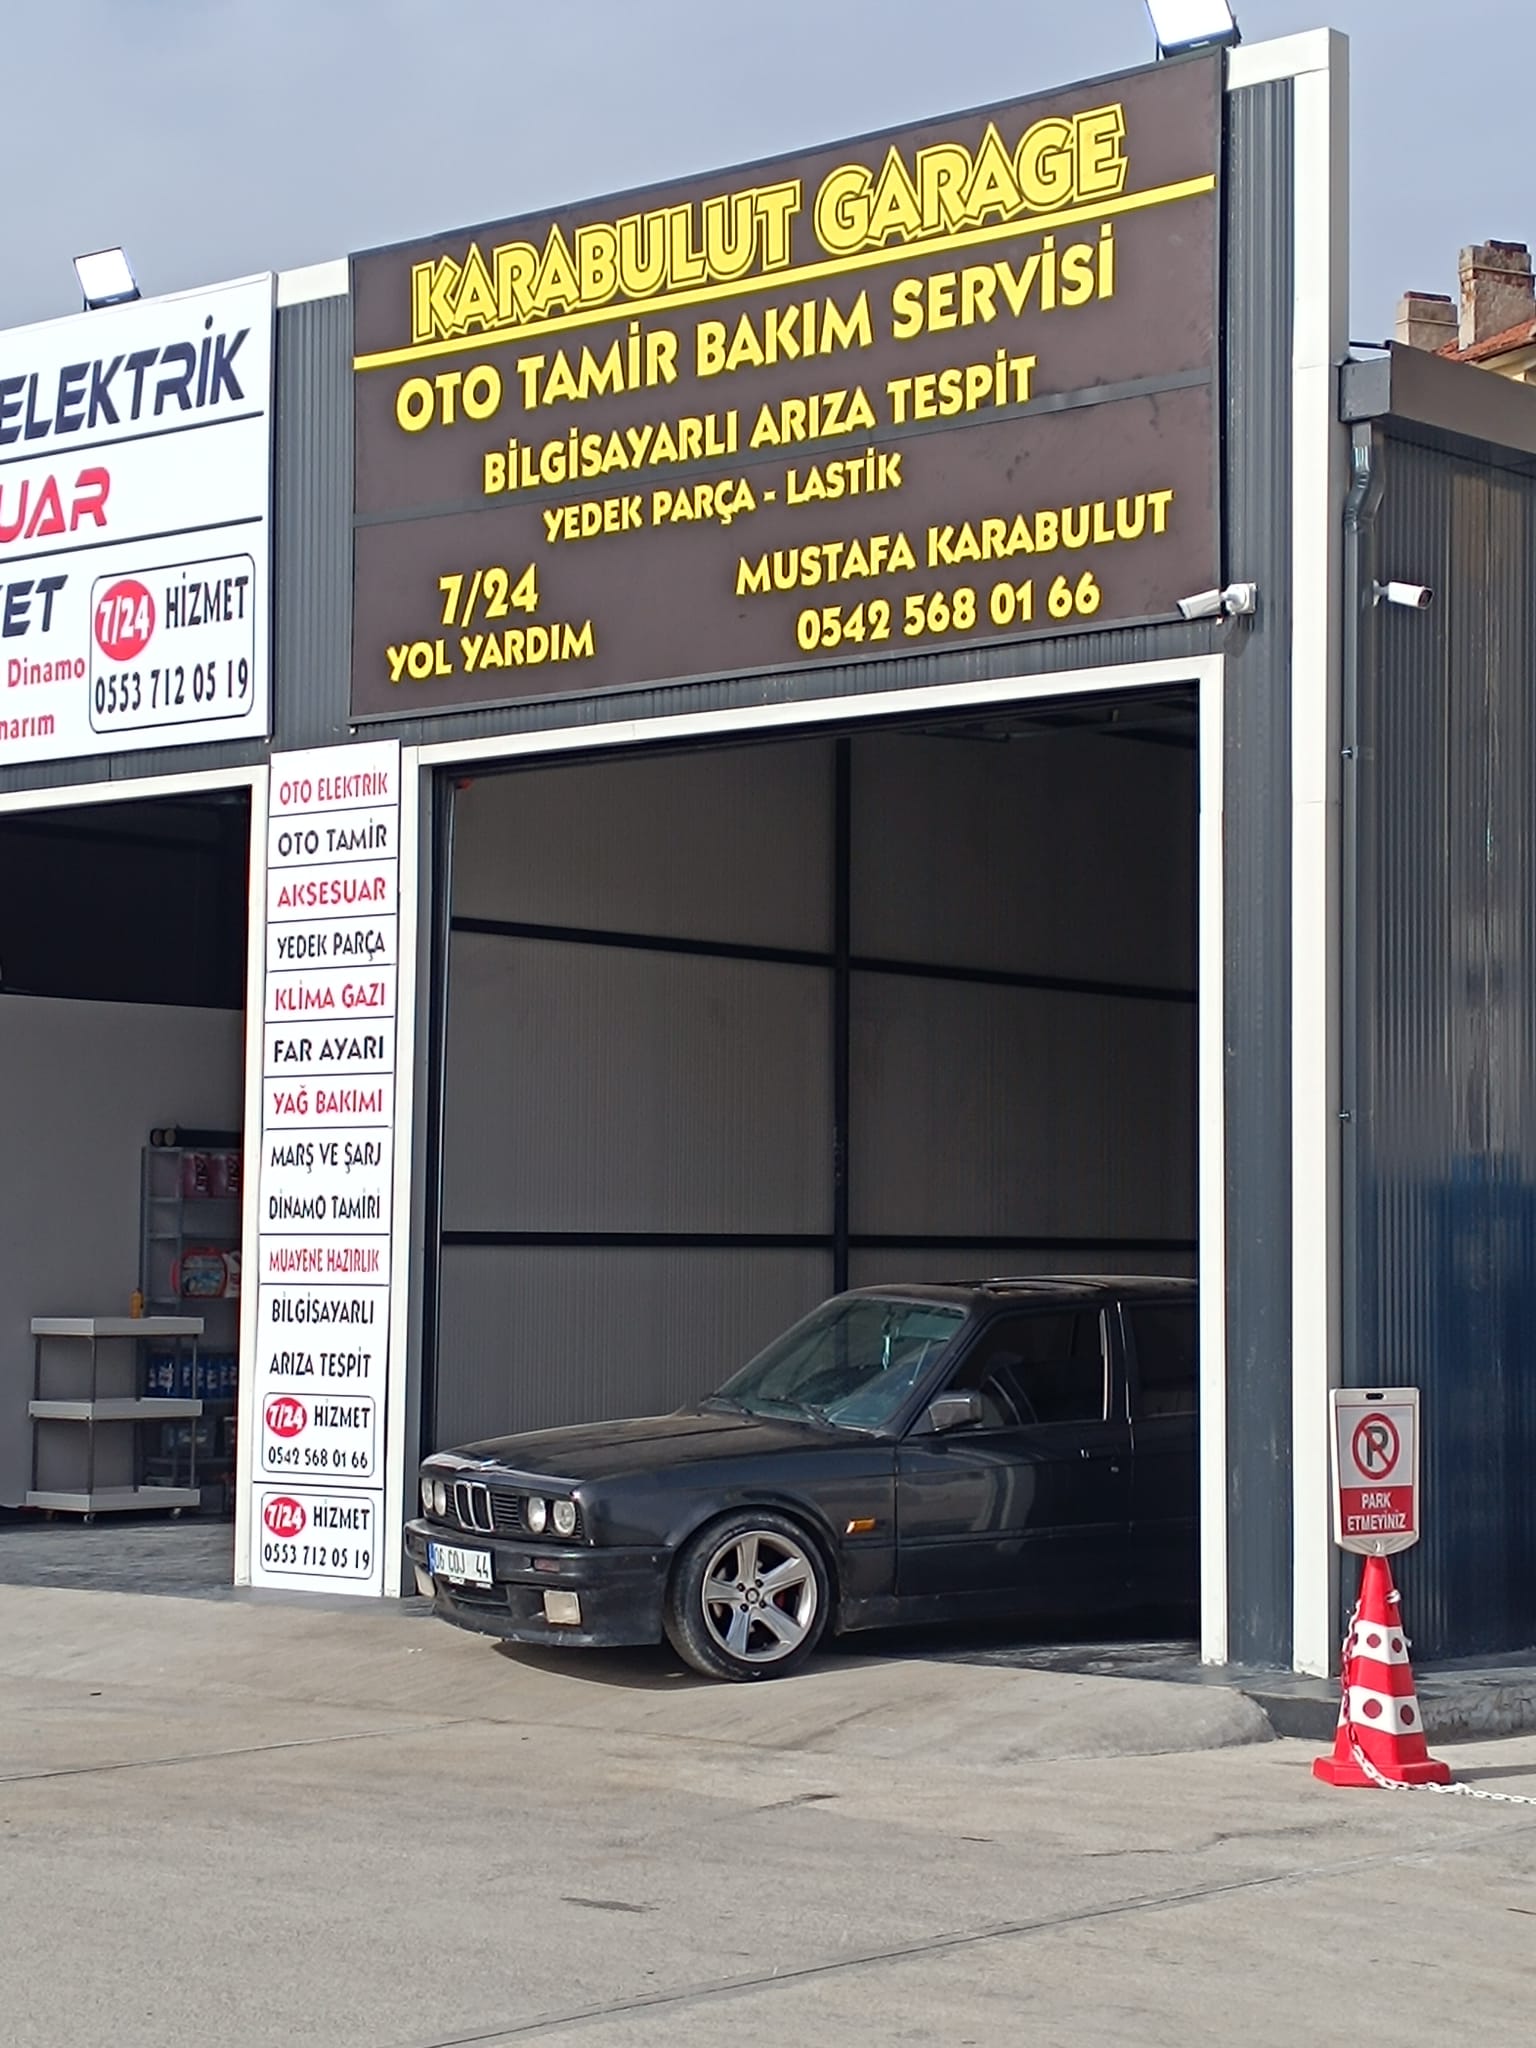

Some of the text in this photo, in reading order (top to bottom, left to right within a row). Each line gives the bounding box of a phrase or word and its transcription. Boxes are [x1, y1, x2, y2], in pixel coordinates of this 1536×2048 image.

[412, 103, 1128, 343] KARABULUT GARAGE
[396, 222, 1114, 432] OTO TAMİR BAKIM SERVİSİ
[0, 314, 250, 445] ELEKTRİK
[484, 348, 1037, 495] BİLGİSAYARLI ARIZA TESPİT
[543, 495, 643, 542] YEDEK
[652, 478, 756, 525] PARÇA
[787, 447, 902, 505] LASTİK
[736, 490, 1174, 596] MUSTAFA KARABULUT
[0, 575, 68, 637] ET
[99, 571, 249, 645] 7/24 HİZMET
[439, 563, 539, 628] 7/24
[797, 571, 1101, 650] 0542 568 01 66
[386, 619, 596, 682] YOL YARDIM
[8, 657, 85, 687] Dinamo
[95, 657, 248, 714] 0553 712 05 19
[279, 764, 388, 806] OTO ELEKTRİK
[278, 817, 388, 857] OTO TAMİR
[277, 876, 386, 908] AKSESUAR
[277, 929, 385, 961] YEDEK PARÇA
[274, 980, 385, 1012] KLİMA GAZI
[273, 1034, 384, 1063] FAR AYARI
[273, 1085, 383, 1116] YAĞ BAKIMI
[271, 1144, 315, 1174] MARŞ
[318, 1143, 338, 1167] VE
[343, 1141, 382, 1174] ŞARJ
[268, 1188, 381, 1220] DİNAMO TAMİRİ
[269, 1248, 380, 1273] MUAYENE HAZIRLIK
[271, 1292, 375, 1325] BİLGİSAYARLI
[269, 1351, 315, 1377] ARIZA
[320, 1346, 372, 1379] TESPİT
[267, 1399, 371, 1430] 7/24 HİZMET
[268, 1446, 369, 1469] 0542 568 01 66
[266, 1498, 370, 1531] 7/24 HİZMET
[1361, 1493, 1391, 1509] PARK
[1347, 1509, 1406, 1531] ETMEYİNİZ
[264, 1543, 370, 1571] 0553 712 05 19
